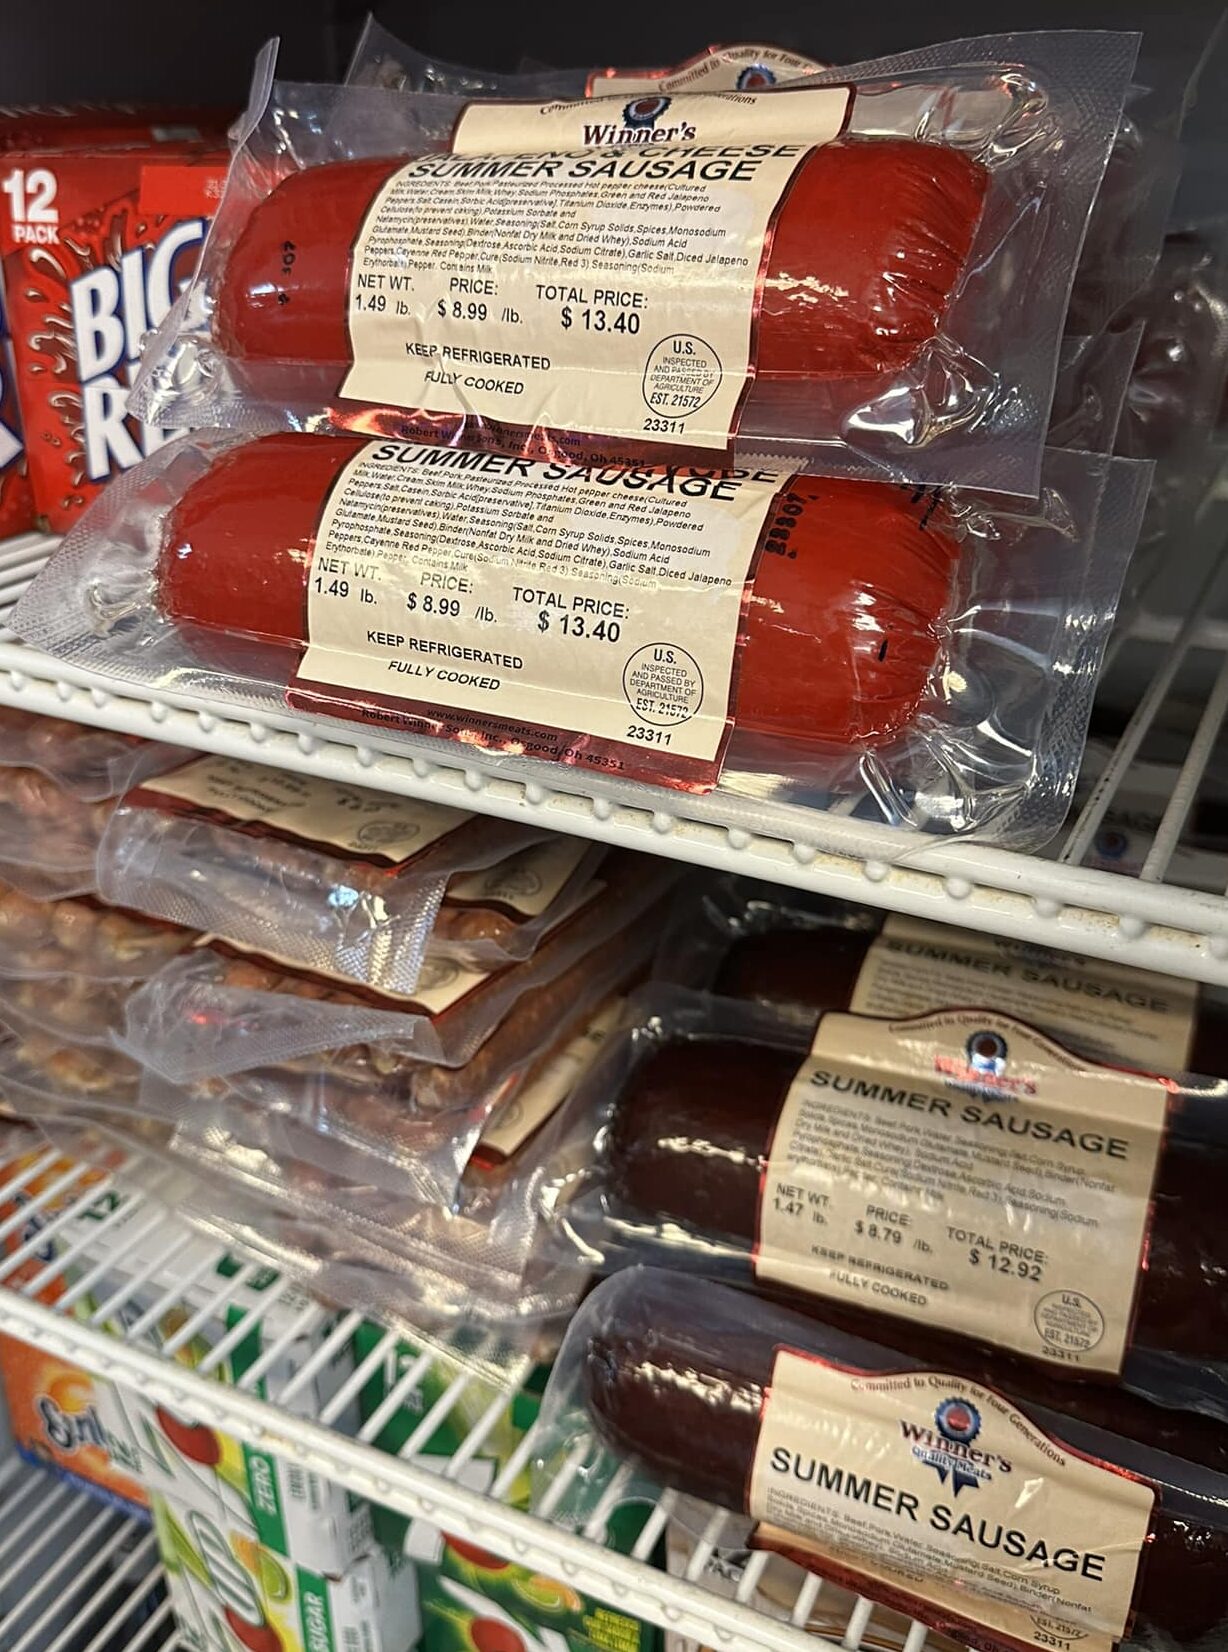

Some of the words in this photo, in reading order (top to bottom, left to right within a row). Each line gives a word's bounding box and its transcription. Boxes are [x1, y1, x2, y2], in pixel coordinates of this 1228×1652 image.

[582, 122, 696, 146] Winner's
[408, 161, 563, 178] SUMMER
[568, 160, 762, 181] SAUSAGE
[3, 168, 59, 223] 12
[631, 192, 645, 200] and
[647, 192, 666, 201] Red
[667, 193, 709, 203] Jalapeno
[526, 208, 557, 218] Sorbate
[559, 209, 576, 218] and
[14, 223, 61, 243] PACK
[580, 221, 605, 232] Syrup
[523, 231, 537, 241] Dry
[538, 232, 556, 241] Milk
[558, 233, 575, 242] and
[576, 233, 599, 243] Dried
[667, 239, 687, 248] Acid
[431, 248, 447, 258] Red
[705, 254, 748, 266] Jalapeno
[476, 264, 493, 273] Milk
[358, 274, 386, 289] NET
[389, 276, 415, 291] WT.
[450, 277, 498, 296] PRICE:
[355, 294, 387, 312] 1.49
[396, 301, 411, 316] lb.
[536, 284, 588, 304] TOTAL
[594, 289, 648, 309] PRICE:
[452, 302, 488, 321] 8.99
[582, 309, 640, 335] 13.40
[405, 342, 437, 357] KEEP
[442, 346, 551, 371] REFRIGERATED
[673, 340, 696, 356] U.S.
[654, 364, 670, 374] AND
[663, 356, 707, 369] INSPECTED
[424, 371, 462, 385] FULLY
[464, 376, 525, 395] COOKED
[650, 374, 701, 386] DEPARTMENT
[653, 382, 705, 395] AGRICULTURE
[650, 392, 670, 406] EST.
[671, 394, 701, 409] 21572
[643, 418, 685, 435] 23311
[372, 445, 535, 478] SUMMER
[542, 464, 742, 501] SAUSAGE
[515, 479, 560, 492] Processed
[561, 484, 577, 495] Hot
[578, 487, 610, 500] pepper
[391, 493, 423, 507] prevent
[501, 509, 535, 522] Sorbate
[536, 514, 555, 524] and
[608, 498, 626, 510] and
[628, 502, 647, 513] Red
[648, 505, 691, 521] Jalapeno
[559, 527, 585, 541] Syrup
[402, 541, 419, 552] Red
[499, 531, 516, 544] Dry
[517, 533, 535, 545] Milk
[536, 537, 554, 548] and
[554, 539, 579, 552] Dried
[649, 553, 670, 564] Acid
[317, 557, 349, 575] NET
[420, 572, 474, 594] PRICE:
[687, 571, 732, 587] Jalapeno
[314, 577, 349, 598] 1.49
[360, 588, 378, 605] lb.
[422, 595, 460, 617] 8.99
[512, 586, 567, 610] TOTAL
[572, 596, 630, 620] PRICE:
[559, 614, 620, 643] 13.40
[367, 630, 405, 647] KEEP
[409, 637, 523, 670] REFRIGERATED
[653, 648, 677, 665] U.S.
[388, 660, 435, 678] FULLY
[436, 669, 501, 691] COOKED
[632, 670, 649, 680] AND
[650, 673, 682, 686] PASSED
[683, 678, 696, 688] BY
[641, 663, 688, 678] INSPECTED
[629, 678, 684, 694] DEPARTMENT
[685, 687, 697, 697] OF
[636, 687, 689, 704] AGRICULTURE
[627, 725, 672, 746] 23311
[585, 753, 625, 770] 45351
[1021, 967, 1169, 1012] SAUSAGE
[810, 1069, 952, 1118] SUMMER
[960, 1103, 1130, 1160] SAUSAGE
[776, 1183, 804, 1200] NET
[773, 1197, 804, 1216] 1.47
[866, 1204, 911, 1226] PRICE:
[868, 1223, 902, 1244] 8.79
[947, 1224, 996, 1250] TOTAL
[998, 1239, 1048, 1265] PRICE:
[848, 1253, 949, 1290] REFRIGERATED
[989, 1251, 1043, 1282] 12.92
[871, 1280, 928, 1306] COOKED
[914, 1378, 926, 1387] to
[927, 1375, 968, 1392] Quality
[1009, 1412, 1067, 1467] Generations
[900, 1419, 1013, 1474] Winner's
[249, 1455, 277, 1517] ZERO
[771, 1447, 919, 1521] SUMMER
[929, 1504, 1106, 1583] SAUSAGE
[1034, 1630, 1071, 1651] 23311
